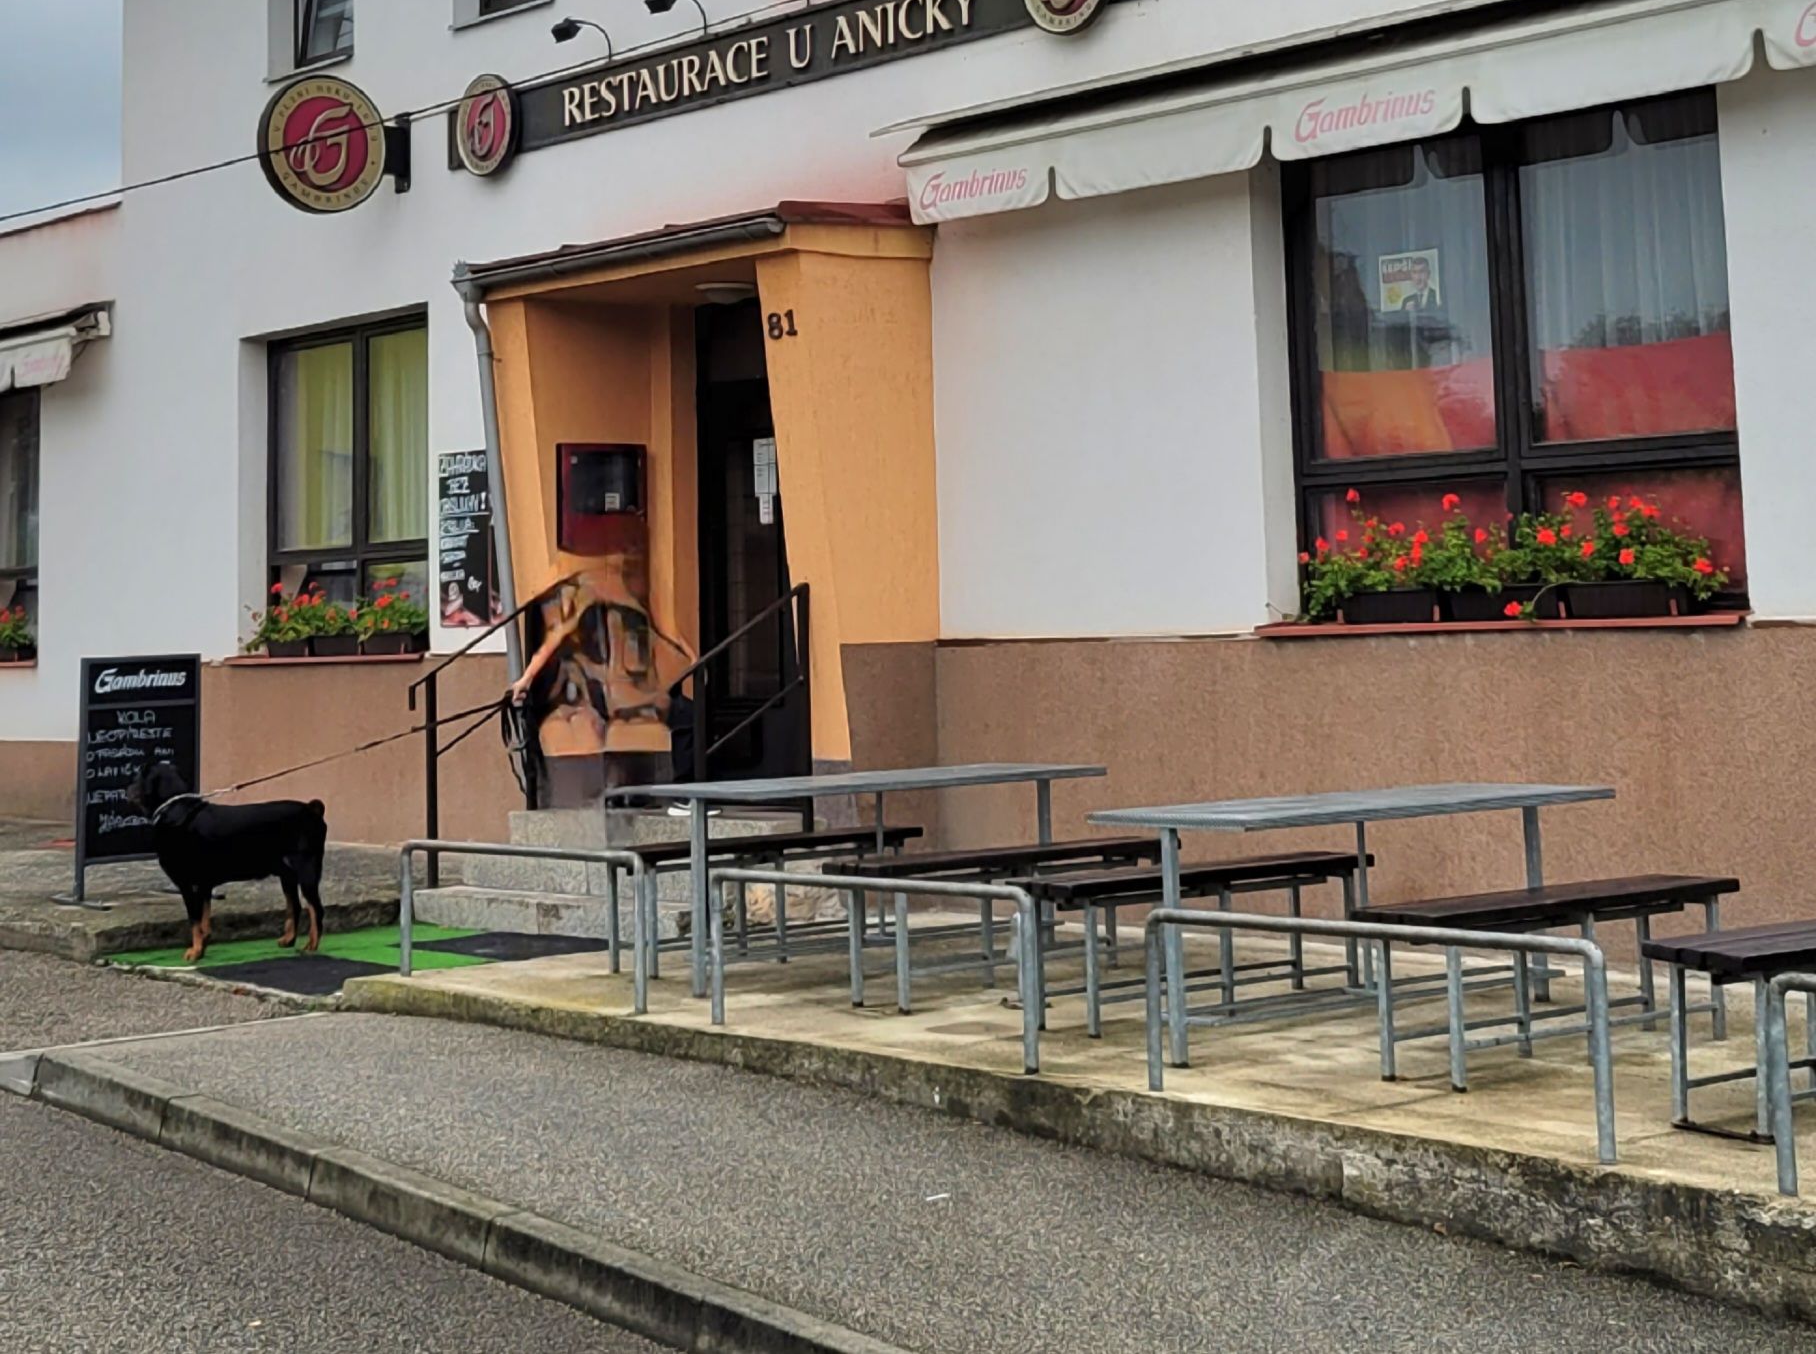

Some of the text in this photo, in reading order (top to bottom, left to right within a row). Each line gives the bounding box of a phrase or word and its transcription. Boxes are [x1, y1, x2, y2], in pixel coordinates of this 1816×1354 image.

[562, 36, 769, 127] RESTAURACE
[786, 24, 812, 69] U
[1295, 89, 1436, 143] Gambrinus
[920, 168, 1028, 211] Gambrinus
[767, 308, 798, 341] 81
[94, 668, 187, 694] Gambrinus
[116, 710, 156, 726] KOLA
